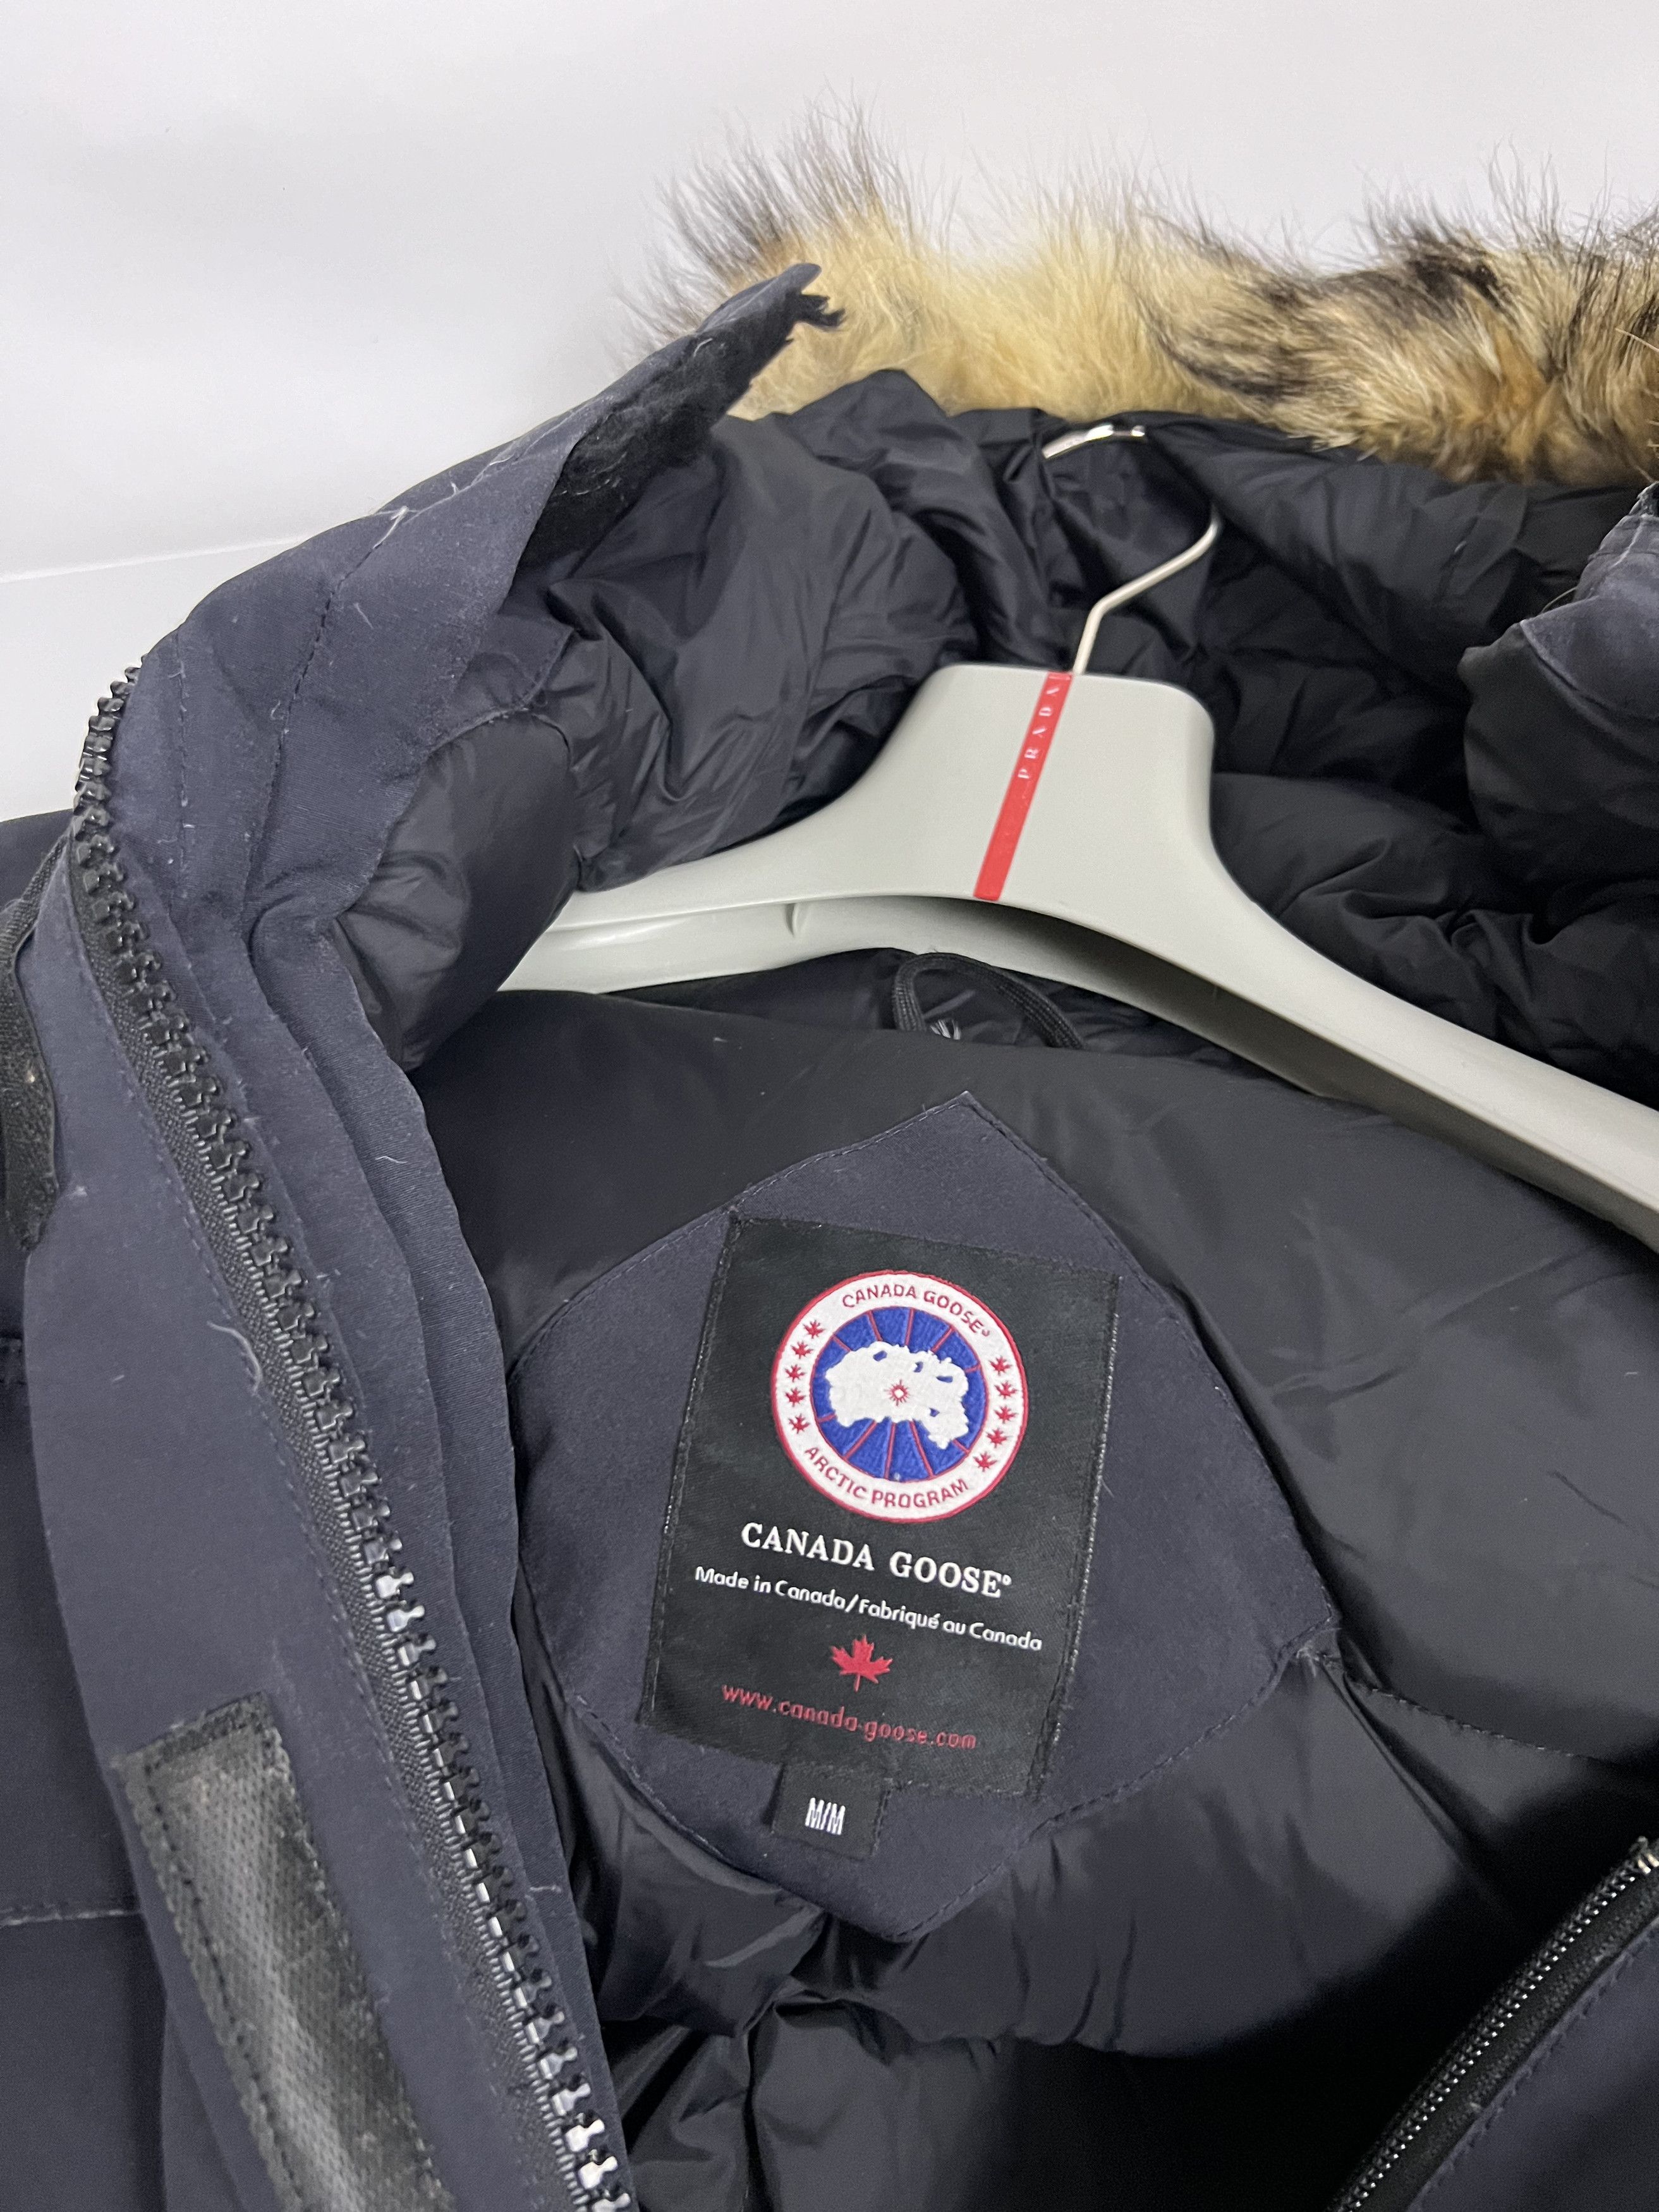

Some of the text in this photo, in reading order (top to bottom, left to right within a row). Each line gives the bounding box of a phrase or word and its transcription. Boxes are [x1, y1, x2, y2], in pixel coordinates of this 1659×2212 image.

[1018, 686, 1060, 779] PRADA
[842, 1284, 916, 1308] CANADA
[805, 1447, 969, 1509] ARCTIC PROGRAM
[741, 1522, 875, 1571] CANADA
[695, 1566, 749, 1589] Made
[753, 1575, 771, 1593] in
[943, 1620, 966, 1635] au
[969, 1622, 1042, 1651] Canada
[805, 1797, 846, 1835] M/M
